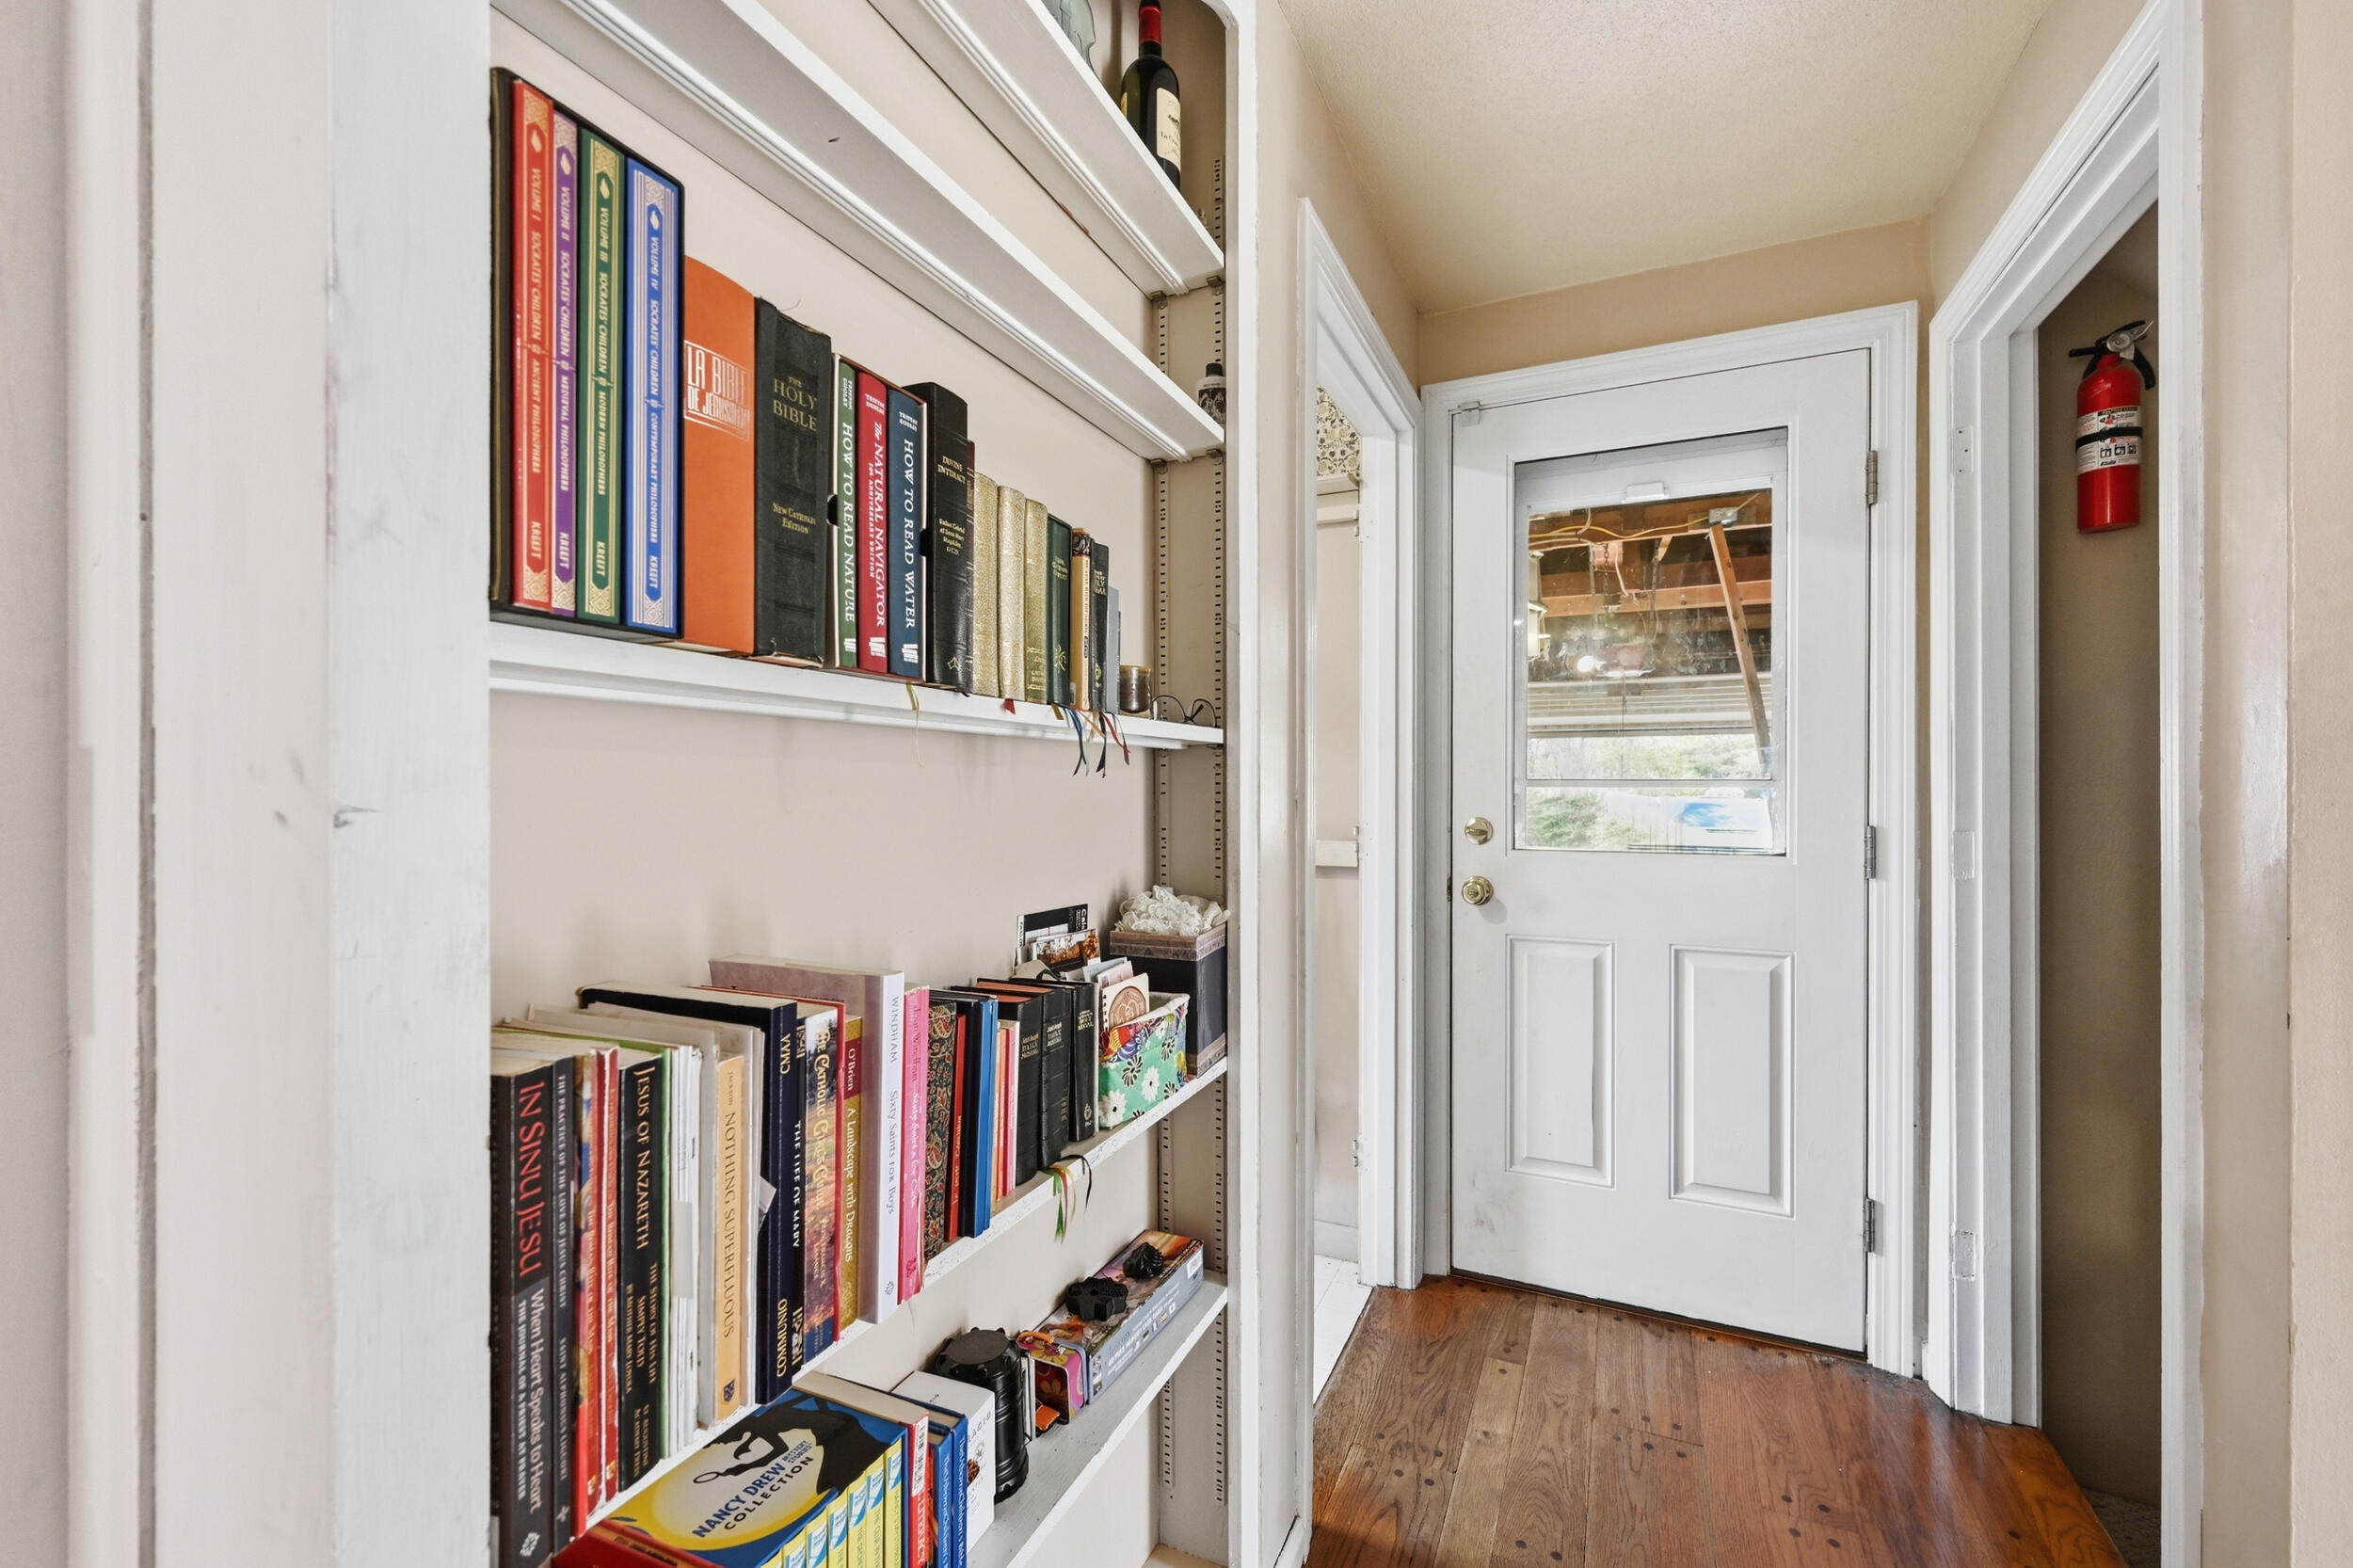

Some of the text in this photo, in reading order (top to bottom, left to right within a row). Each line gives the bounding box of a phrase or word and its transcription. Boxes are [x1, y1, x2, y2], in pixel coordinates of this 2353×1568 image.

[532, 168, 542, 212] VOLUME
[532, 230, 542, 287] SOCRATES'
[532, 287, 542, 340] CHILDREN
[532, 359, 540, 402] ANCIENT
[559, 186, 570, 568] VOLUME II SOCRATES' CHILDREN MEDIEVAL PHILOSOPHERS KREEFT
[596, 207, 609, 577] VOLUME III SOCRATES' CHILDREN MODERN PHILOSOPHERS KREEFT
[687, 345, 746, 407] LA BIBLE
[774, 378, 818, 410] HOLY
[788, 376, 802, 388] THE
[648, 236, 660, 589] VOLUME IV SOCRATES' CHILDREN CONTEMPORARY PHILOSOPHERS KREEFT
[687, 385, 700, 412] DE
[773, 400, 818, 432] BIBLE
[532, 405, 540, 473] PHILOSOPHERS
[531, 521, 541, 560] KREEFT
[842, 422, 856, 621] HOW TO READ NATURE
[874, 422, 886, 627] The NATURAL NAVIGATOR
[904, 439, 916, 629] HOW TO READ WATER
[890, 996, 900, 1063] WINDHAM
[779, 1033, 792, 1075] CMAA
[846, 1048, 856, 1091] O'Brien
[558, 1074, 567, 1094] THE
[814, 1054, 830, 1116] CATHOLIC
[558, 1097, 567, 1149] PRACTICE
[847, 1107, 856, 1117] A
[888, 1091, 899, 1121] Sixty
[558, 1152, 567, 1165] OF
[633, 1066, 655, 1249] JESUS OF NAZARETH
[724, 1112, 736, 1204] NOTHING
[843, 1120, 856, 1177] Landscape
[889, 1124, 898, 1158] Saints
[515, 1081, 546, 1277] IN SINU JESU
[558, 1167, 567, 1189] THE
[558, 1192, 567, 1220] LOVE
[887, 1186, 897, 1214] Boys
[558, 1222, 567, 1236] OF
[844, 1211, 856, 1262] Dragons
[558, 1238, 567, 1267] JESUS
[648, 1261, 657, 1283] THE
[723, 1208, 736, 1337] SUPERFLUOUS
[558, 1269, 567, 1307] CHRIST
[648, 1285, 657, 1318] STORY
[518, 1299, 527, 1324] THE
[625, 1294, 633, 1334] MOTHER
[636, 1295, 646, 1368] SIMPLY TOLD
[648, 1320, 657, 1335] OF
[517, 1325, 526, 1374] JOURNAL
[625, 1335, 633, 1358] MARY
[776, 1298, 788, 1377] COMMUNIO
[517, 1376, 526, 1391] OF
[648, 1362, 657, 1384] LIFE
[517, 1401, 526, 1438] PRIEST
[527, 1288, 545, 1513] When Heart Speaks to Heart
[517, 1441, 526, 1455] AT
[517, 1458, 526, 1500] PRAYER
[692, 1463, 786, 1538] NANCY DREW
[724, 1457, 814, 1530] COLLECTION
[917, 1500, 926, 1566] LITERACY
